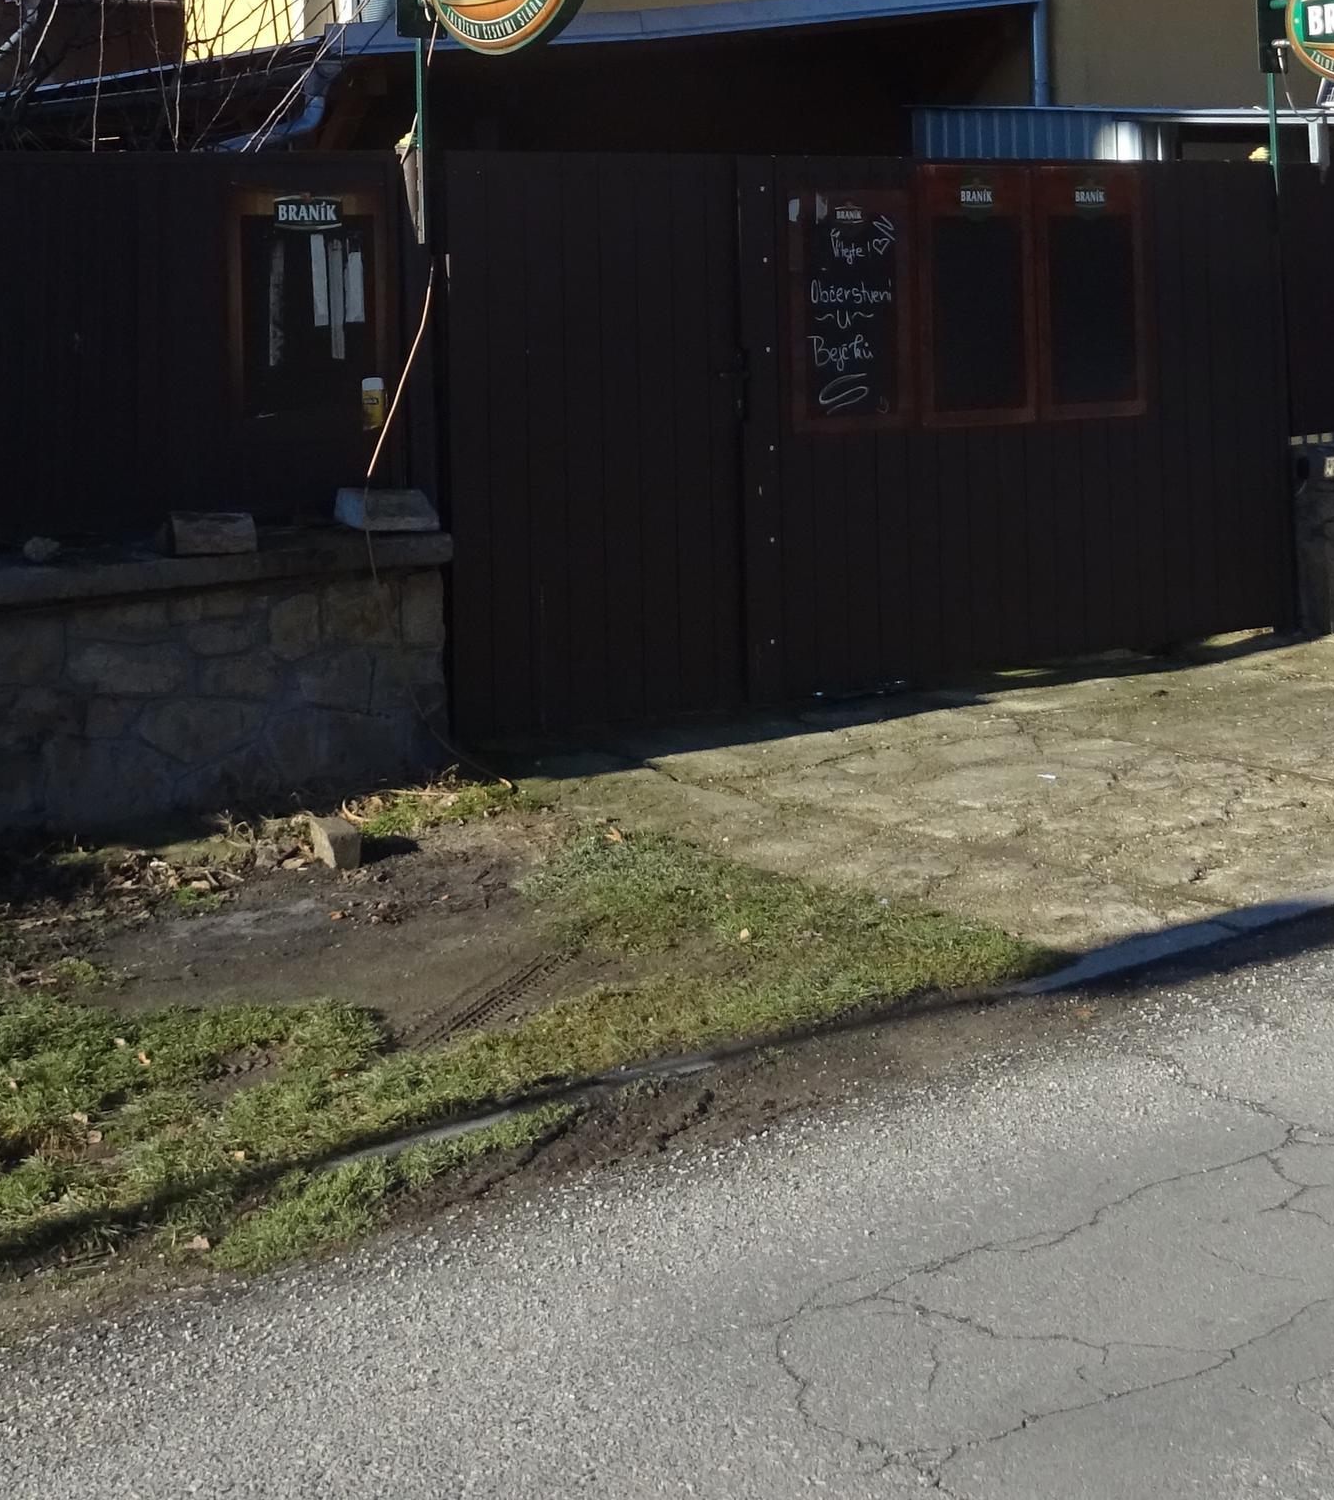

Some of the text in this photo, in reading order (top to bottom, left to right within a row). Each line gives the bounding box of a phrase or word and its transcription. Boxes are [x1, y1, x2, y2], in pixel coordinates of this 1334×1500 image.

[960, 189, 993, 202] BRANÍK
[1075, 190, 1105, 202] BRANÍK
[278, 201, 337, 221] BRANÍK
